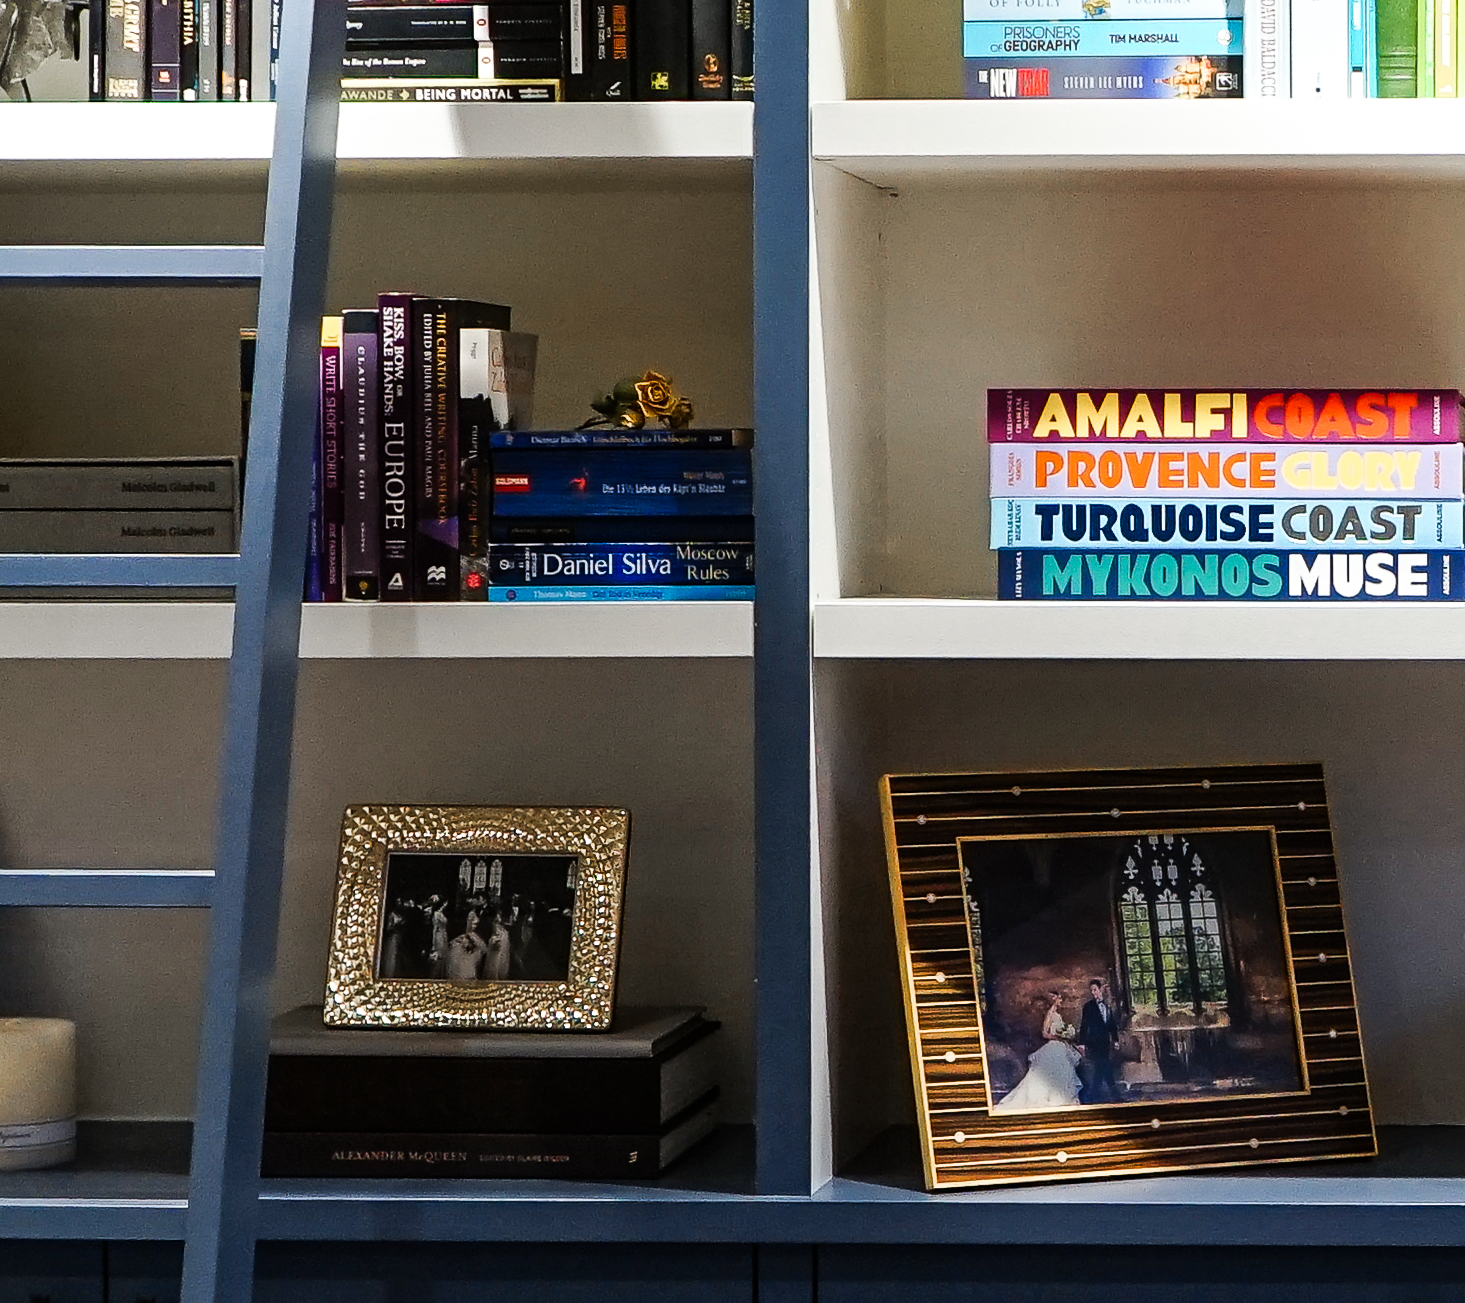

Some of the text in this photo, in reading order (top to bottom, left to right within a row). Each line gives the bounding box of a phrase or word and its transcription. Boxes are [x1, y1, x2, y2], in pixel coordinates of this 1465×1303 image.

[1004, 26, 1080, 39] PRISONERS
[1109, 34, 1178, 43] TIM MARSHALL
[1004, 40, 1080, 51] GEOGRAPHY
[416, 89, 456, 100] BEING
[461, 89, 513, 100] MORTAL
[1033, 393, 1418, 438] AMALFI COAST
[385, 422, 405, 529] EUROPE
[1036, 451, 1421, 491] PROVENCE GLORY
[1035, 505, 1422, 543] TURQUOISE COAST
[676, 546, 738, 560] Moscow
[543, 553, 671, 575] Daniel Silva
[687, 566, 729, 580] Rules
[1042, 553, 1428, 596] MYKONOS MUSE
[332, 1152, 467, 1161] ALEXANDER McQUEEN
